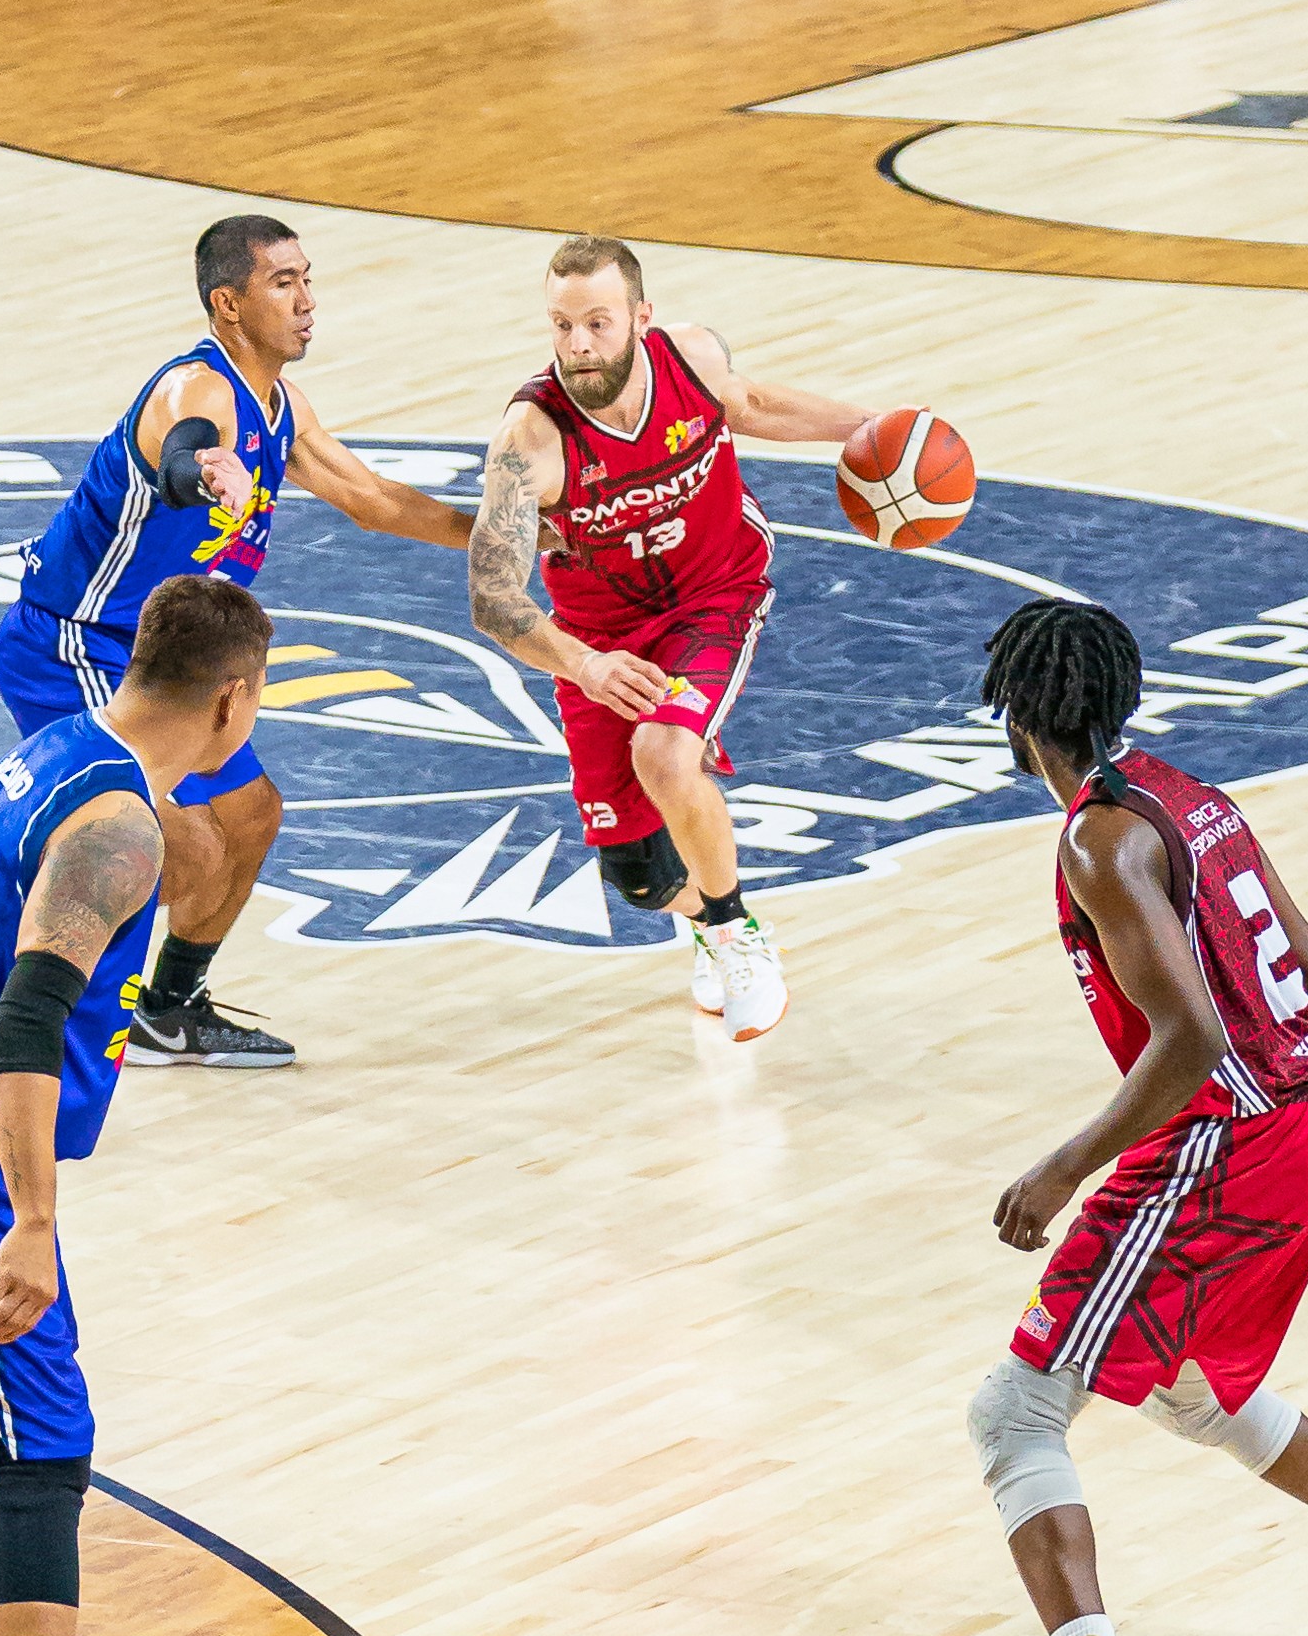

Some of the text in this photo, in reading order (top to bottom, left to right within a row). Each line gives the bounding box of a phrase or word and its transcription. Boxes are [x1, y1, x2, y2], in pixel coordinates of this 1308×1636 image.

[570, 424, 733, 524] DMONTON
[586, 516, 628, 535] ALL
[647, 484, 704, 518] STAR
[623, 517, 687, 560] 13
